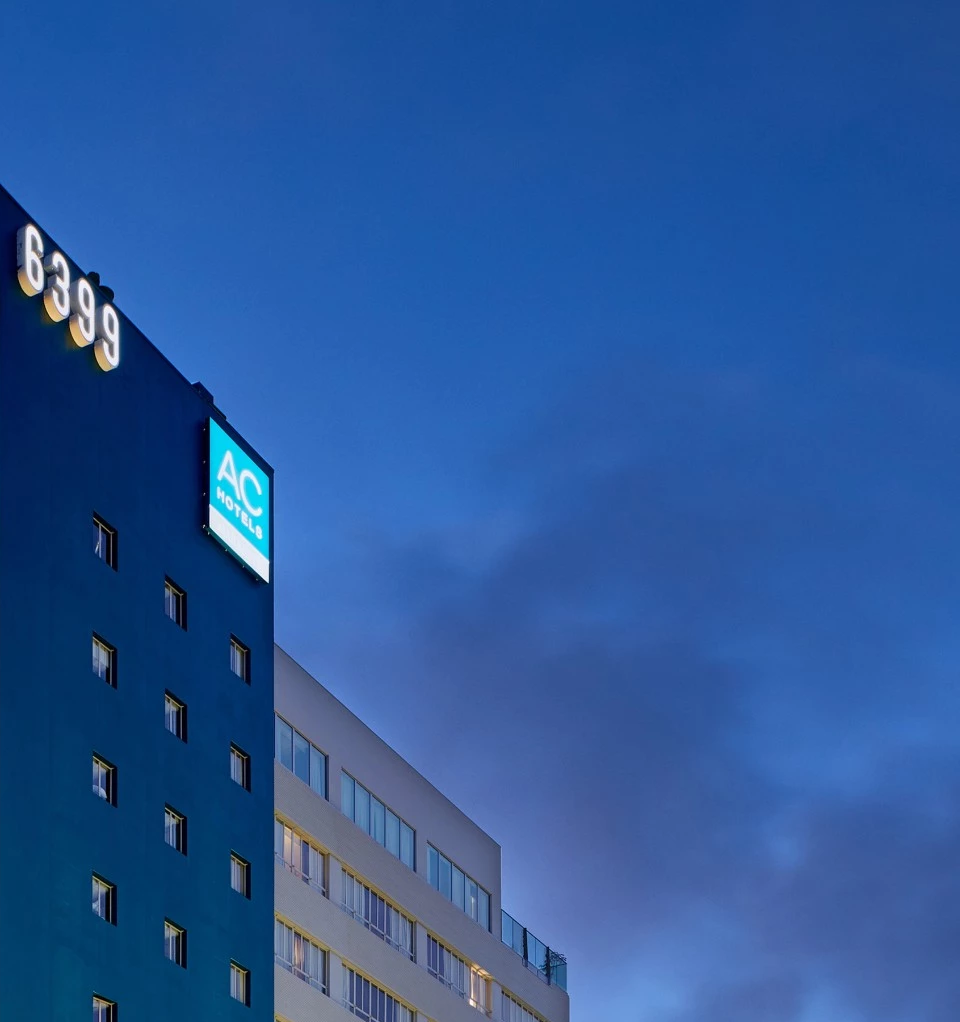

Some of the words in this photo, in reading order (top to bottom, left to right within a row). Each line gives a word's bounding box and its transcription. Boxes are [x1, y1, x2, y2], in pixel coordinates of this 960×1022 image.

[20, 223, 120, 371] 6399
[216, 449, 263, 517] AC
[216, 486, 263, 540] HOTELS
